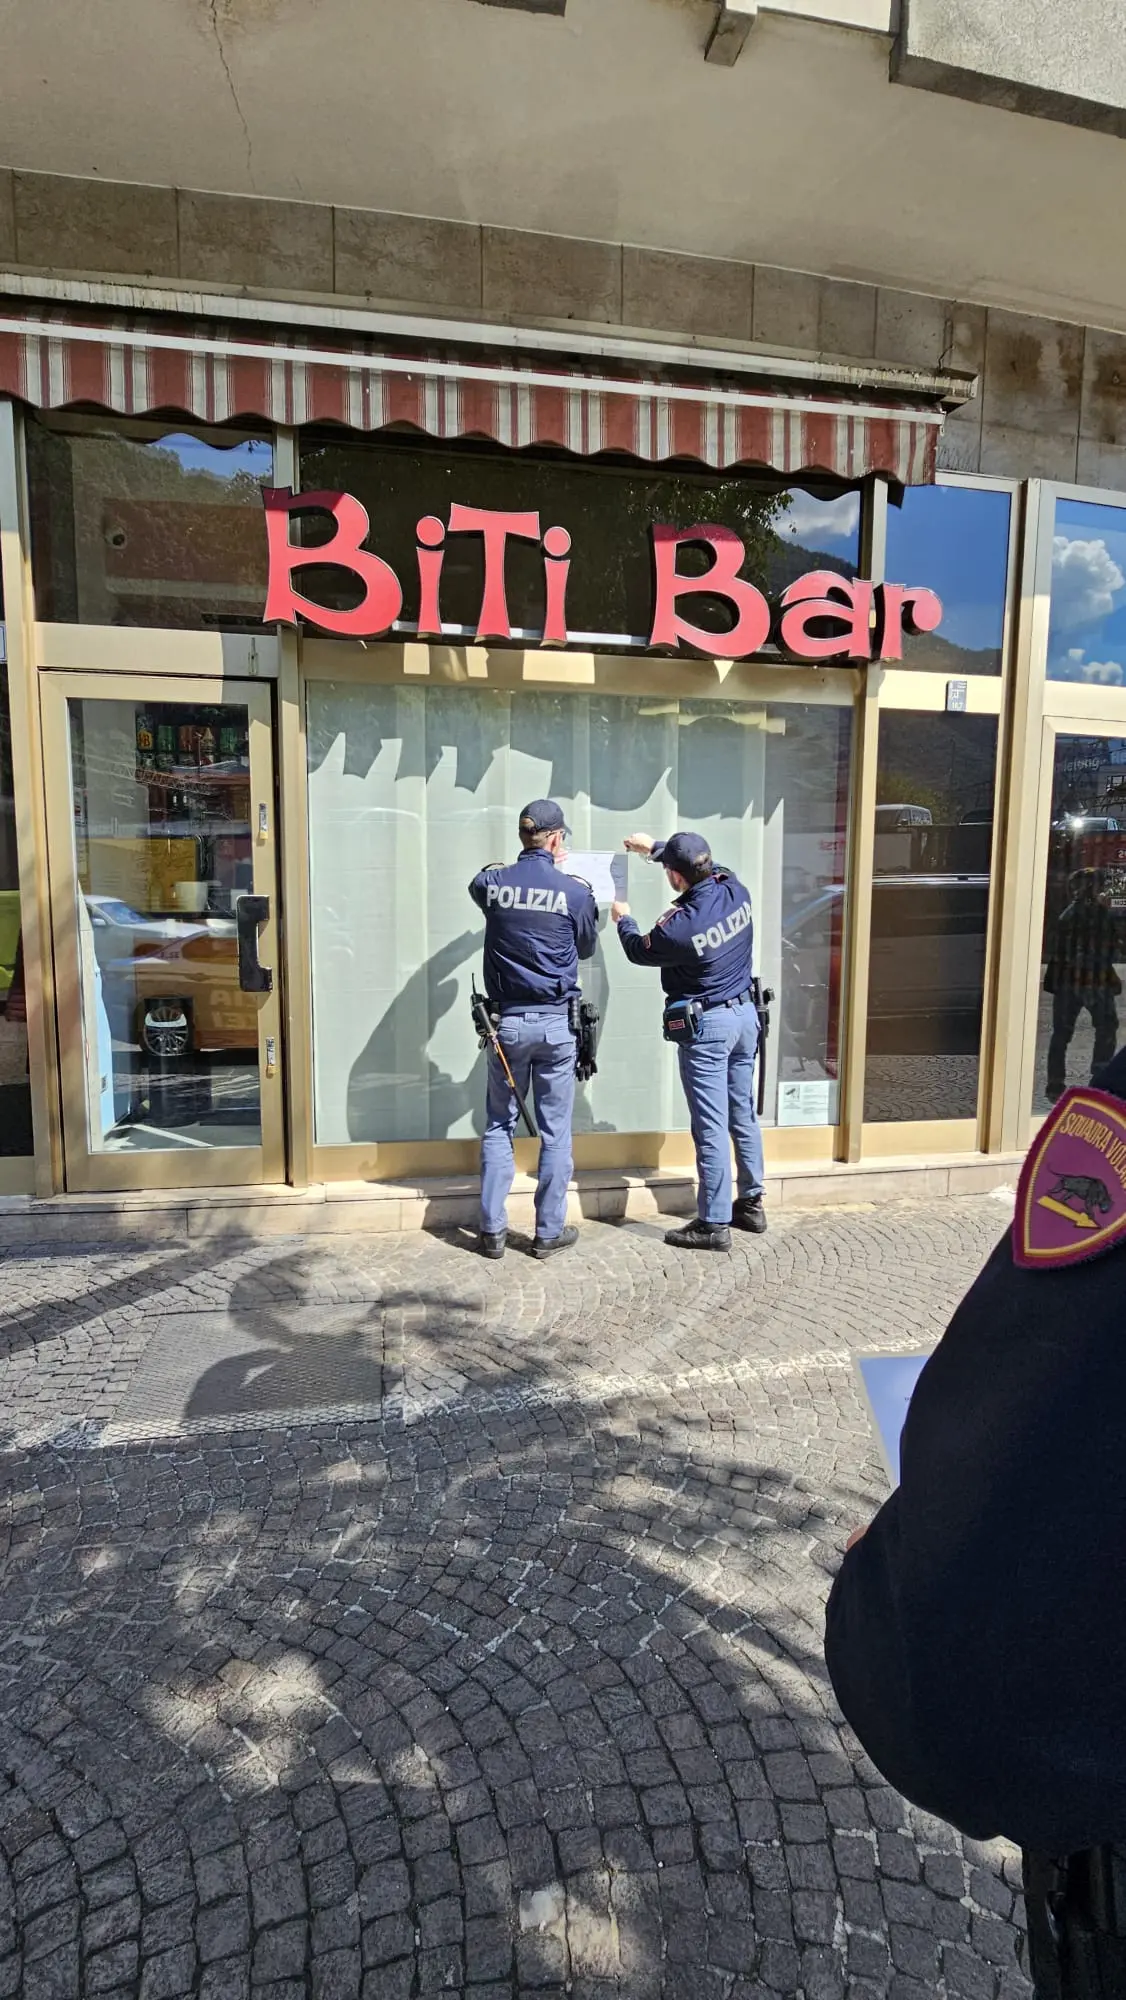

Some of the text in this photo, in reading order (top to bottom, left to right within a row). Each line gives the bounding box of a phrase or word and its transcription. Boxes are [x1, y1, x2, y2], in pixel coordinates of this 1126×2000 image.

[261, 485, 943, 660] BiTi Bar
[486, 884, 569, 916] POLIZIA
[691, 900, 752, 957] POLIZIA
[1060, 1112, 1114, 1153] SQUADRA
